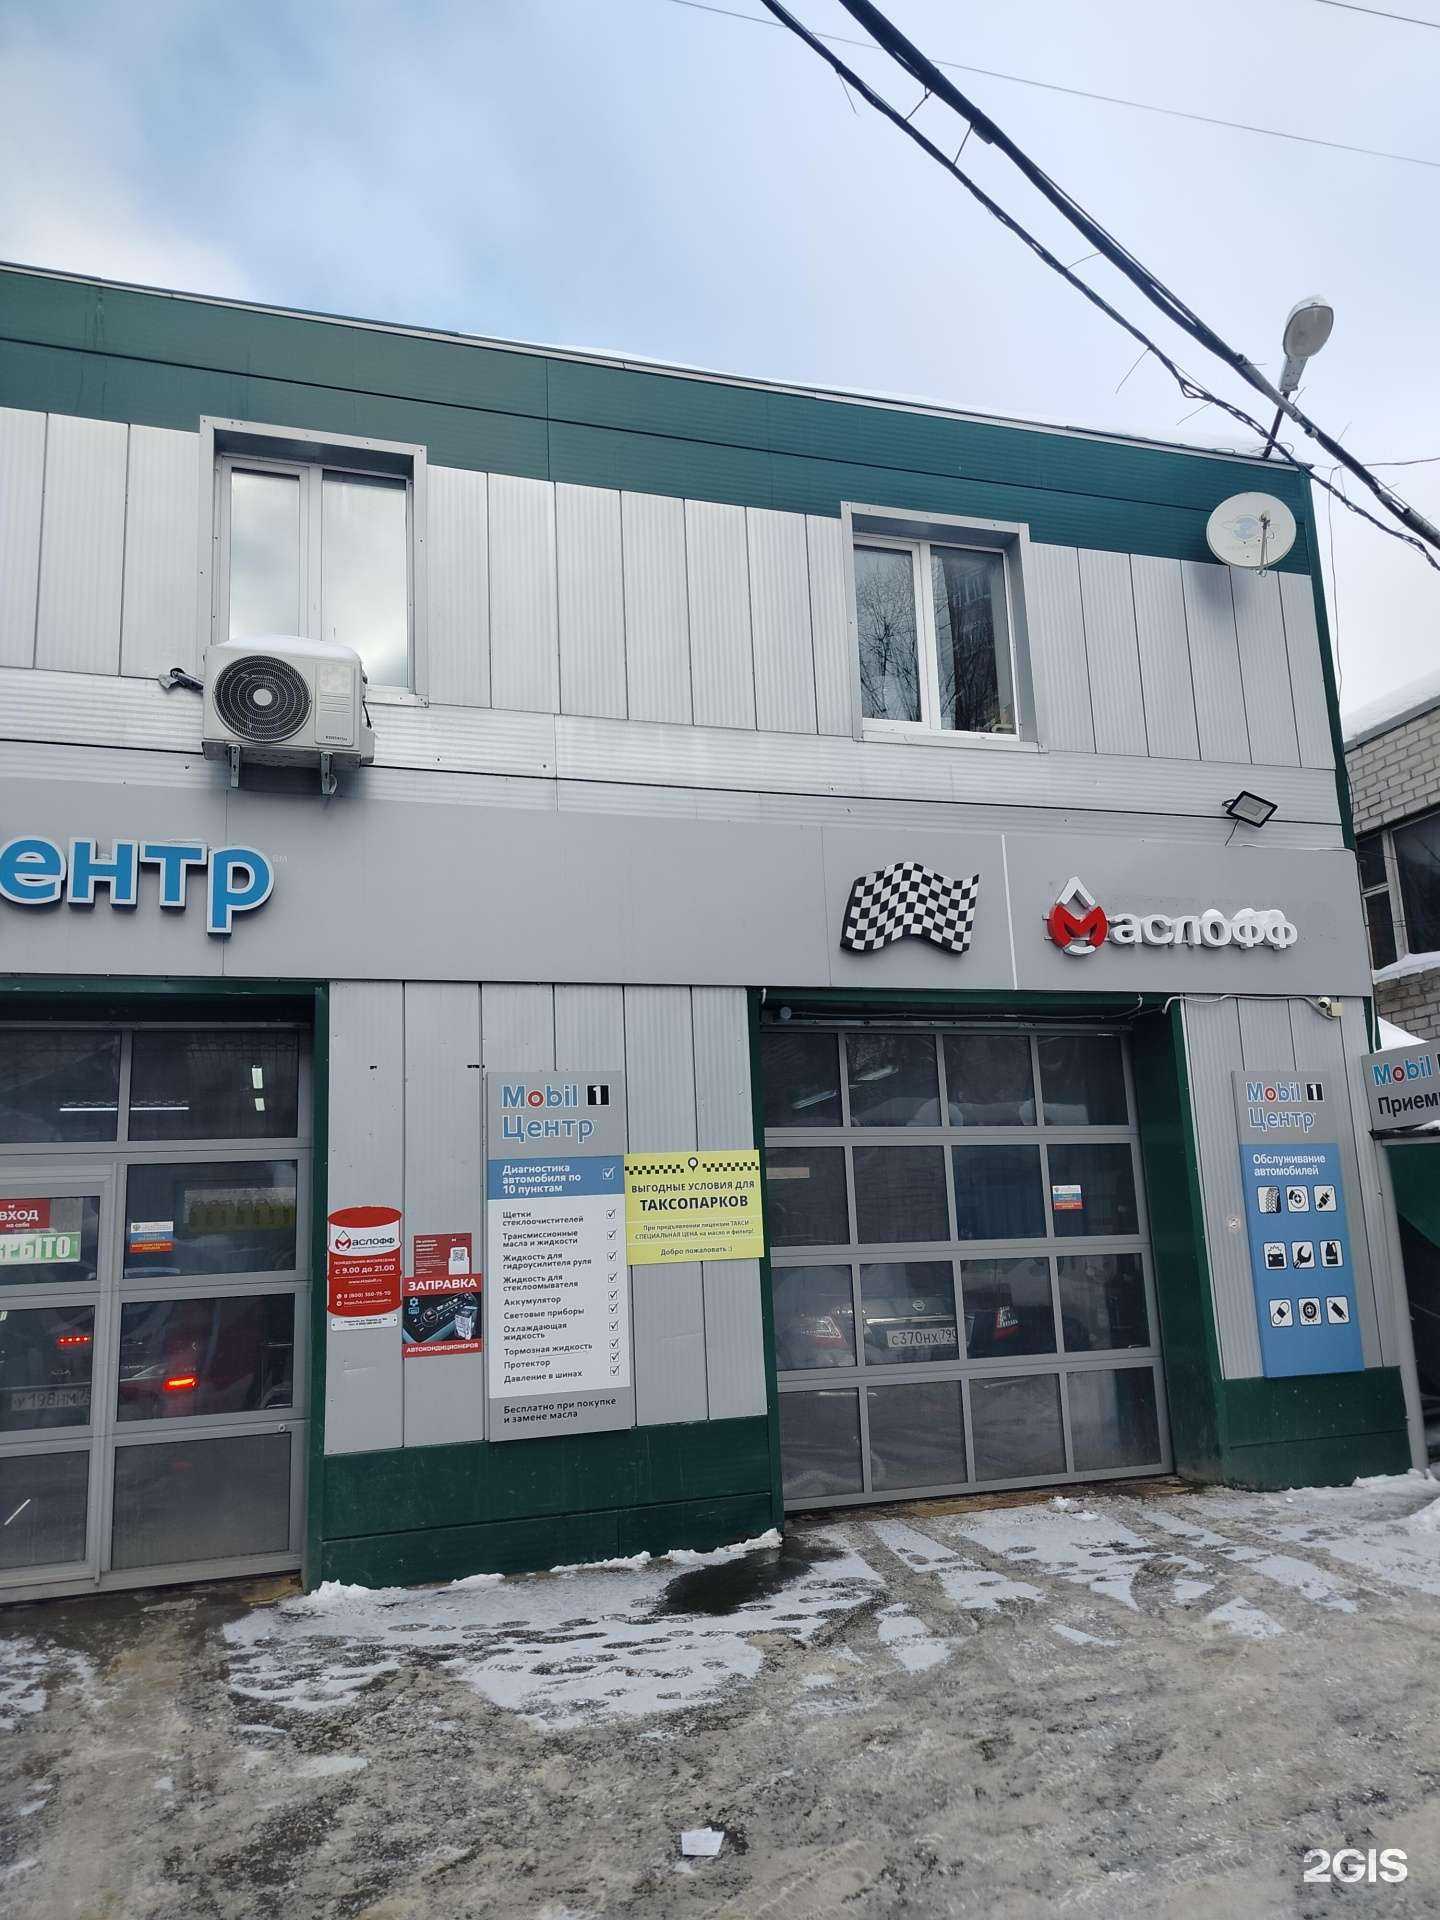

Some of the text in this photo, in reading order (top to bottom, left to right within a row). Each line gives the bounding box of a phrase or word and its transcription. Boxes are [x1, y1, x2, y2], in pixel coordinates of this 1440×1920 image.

[0, 835, 274, 933] ентр
[1046, 903, 1298, 951] Маслофф
[1372, 1055, 1433, 1087] Mobil
[502, 1084, 579, 1108] Mobil
[1246, 1082, 1302, 1102] Mobil
[1378, 1092, 1440, 1117] Прием
[1248, 1107, 1314, 1133] Центр
[502, 1115, 594, 1143] Центр
[1253, 1154, 1326, 1165] Обслуживание
[502, 1165, 570, 1175] Диагностика
[1254, 1166, 1319, 1176] автомобилей
[502, 1174, 566, 1184] автомобиля
[503, 1185, 562, 1195] 10 пунктам
[632, 1181, 755, 1193] ВЫГОДНЫЕ УСЛОВИЯ ДЛЯ
[640, 1195, 748, 1211] ТАКСОПАРКОВ
[0, 1210, 39, 1221] ВХОД
[502, 1211, 532, 1219] Щетки
[502, 1216, 584, 1227] стеклоочистителей
[502, 1230, 578, 1242] Трансмиссионные
[635, 1232, 681, 1240] СПЕЦИАЛЬНАЯ
[682, 1231, 698, 1239] ЦЕНА
[335, 1235, 395, 1250] Маслофф
[503, 1240, 528, 1248] масла
[537, 1238, 578, 1247] жидкости
[503, 1253, 563, 1262] Жидкость для
[660, 1248, 683, 1256] Добро
[503, 1259, 592, 1270] гидроусилителя руля
[408, 1278, 477, 1292] ЗАПРАВКА
[503, 1275, 563, 1284] Жидкость для
[503, 1281, 579, 1292] стеклоомывателя
[504, 1296, 562, 1306] Аккумулятор
[504, 1307, 584, 1320] Световые приборы
[504, 1322, 567, 1333] Охлаждающая
[503, 1332, 546, 1341] жидкость
[406, 1343, 479, 1353] АВТОКОНДИЦИОНЕРОВ
[504, 1343, 593, 1356] Тормозная жидкость
[504, 1360, 551, 1370] Протектор
[504, 1374, 547, 1384] Давление
[555, 1371, 583, 1379] шинах
[504, 1398, 616, 1414] Бесплатно при покупке
[512, 1414, 547, 1423] замене
[550, 1411, 578, 1420] масла
